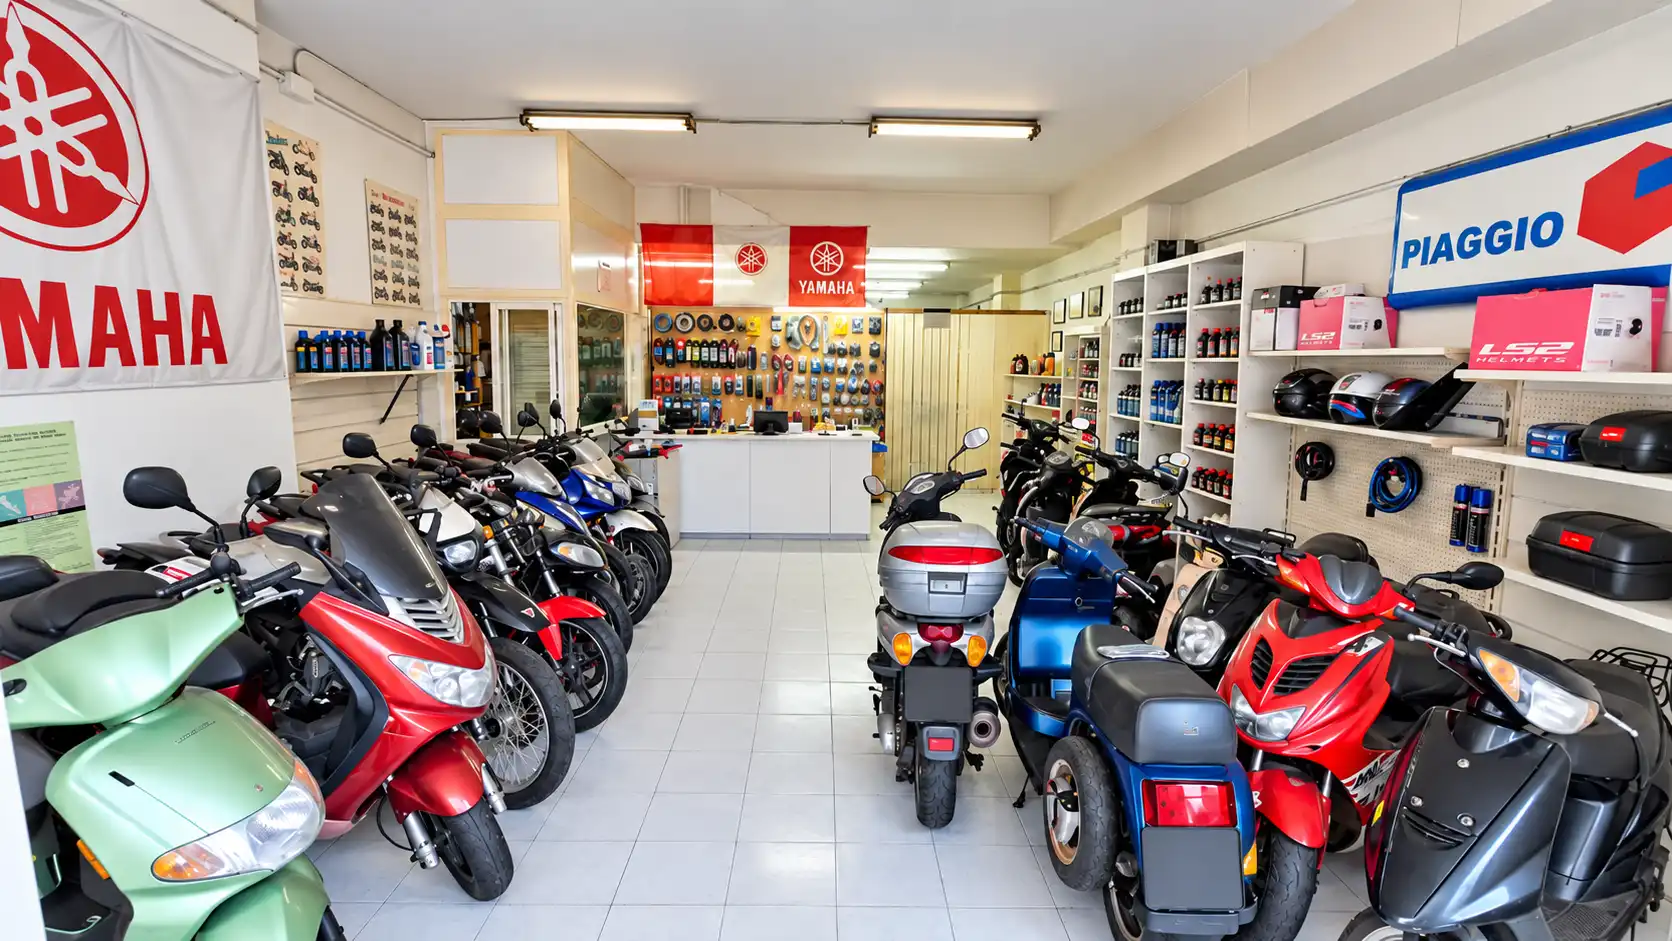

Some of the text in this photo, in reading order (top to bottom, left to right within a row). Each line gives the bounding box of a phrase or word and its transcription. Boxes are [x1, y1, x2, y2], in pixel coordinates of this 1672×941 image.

[1401, 211, 1564, 269] PIAGGIO
[798, 280, 855, 295] YAMAHA
[1301, 331, 1336, 341] LS2
[1478, 341, 1575, 356] LS2
